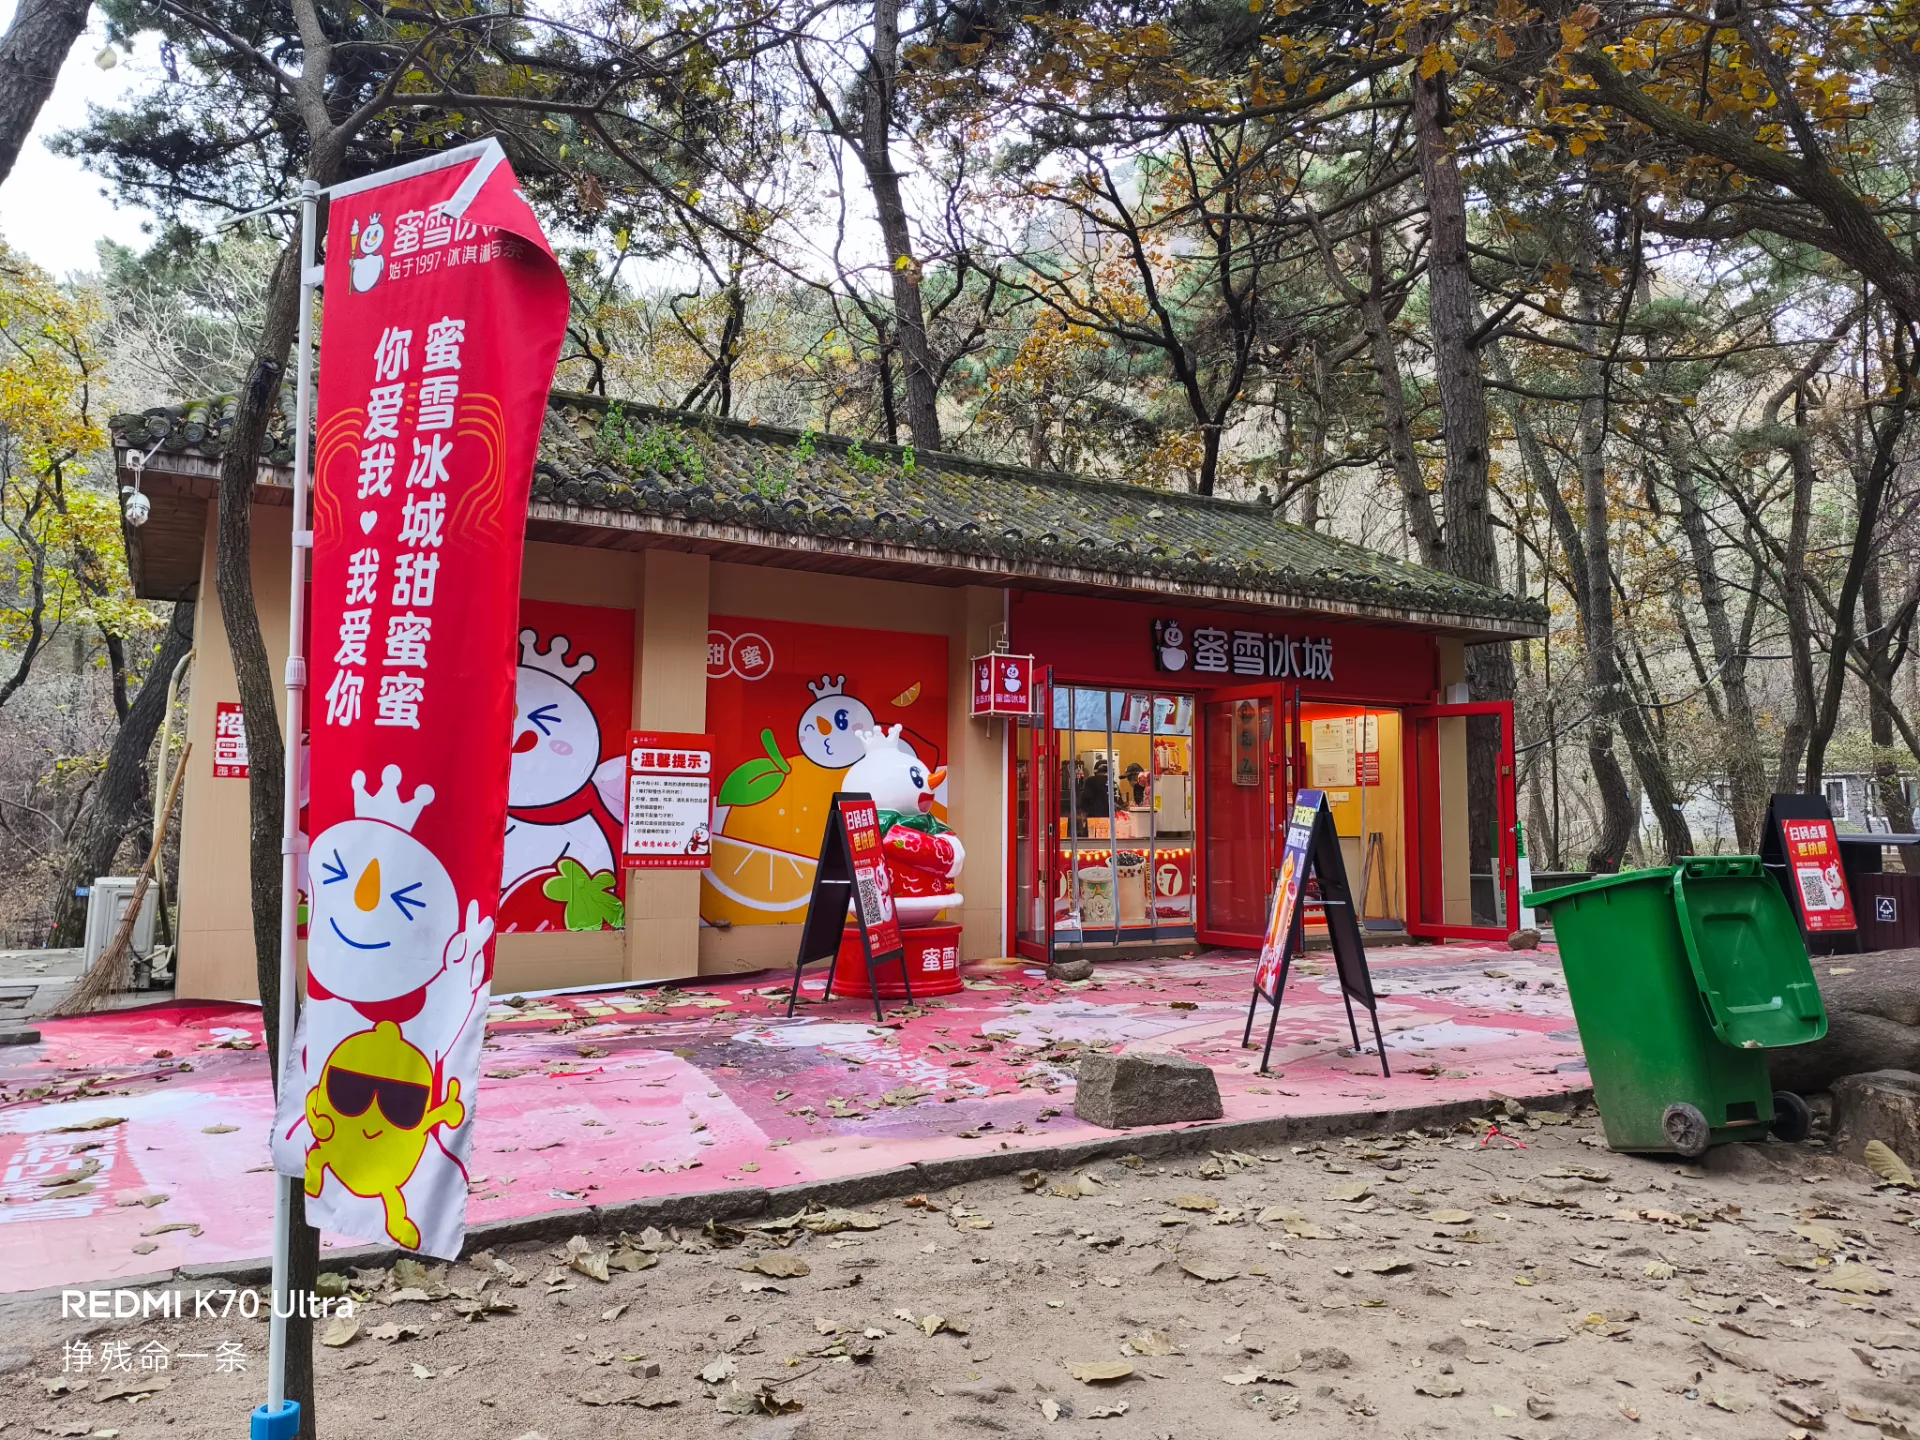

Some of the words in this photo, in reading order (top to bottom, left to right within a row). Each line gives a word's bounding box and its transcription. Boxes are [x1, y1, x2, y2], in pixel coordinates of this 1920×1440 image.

[374, 316, 466, 730] 蜜雪冰城甜蜜蜜
[1193, 627, 1335, 681] 蜜雪冰城
[640, 752, 702, 769] 温馨提示
[1789, 824, 1829, 841] 扫码点餐
[1163, 868, 1178, 895] 7
[922, 947, 960, 971] 蜜雪
